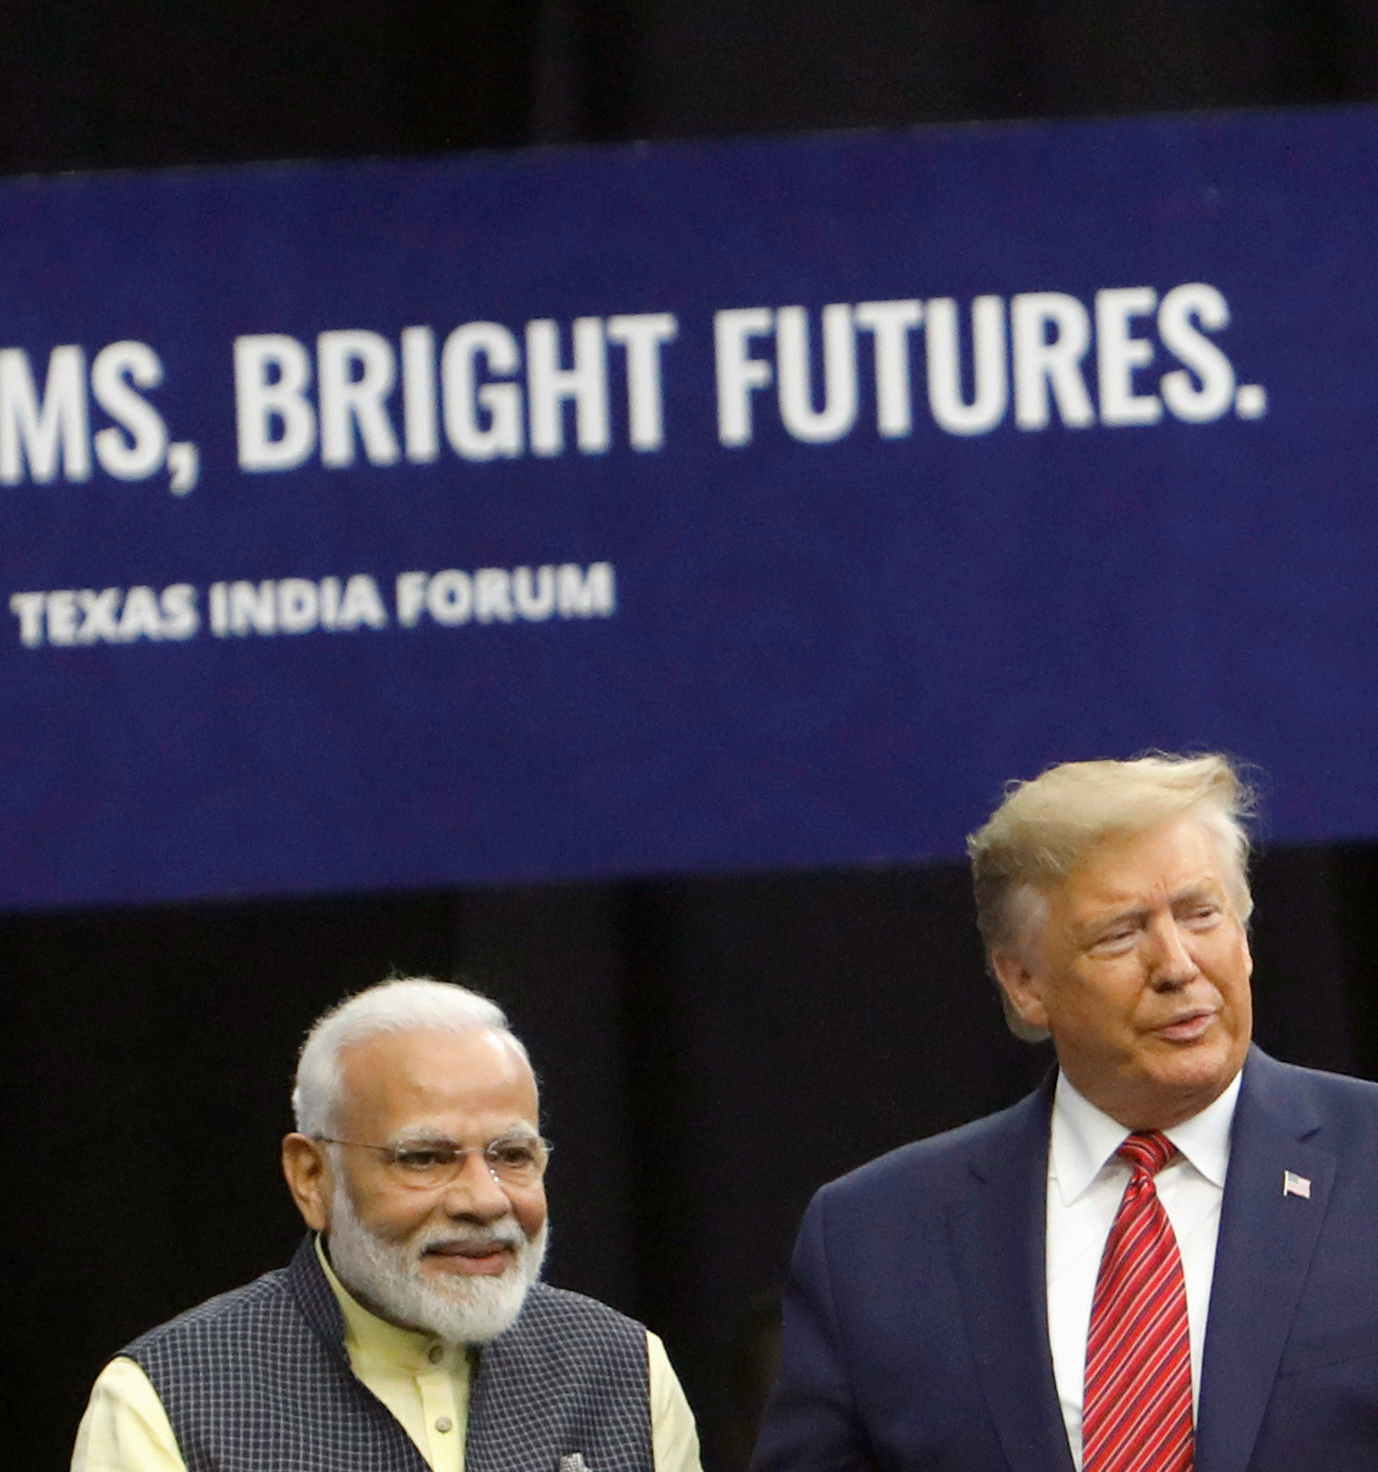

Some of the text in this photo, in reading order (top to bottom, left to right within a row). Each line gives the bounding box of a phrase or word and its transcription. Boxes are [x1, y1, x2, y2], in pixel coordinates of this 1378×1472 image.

[234, 313, 677, 471] BRIGHT
[714, 283, 1266, 445] FUTURES.
[10, 563, 613, 646] TEXAS INDIA FORUM
